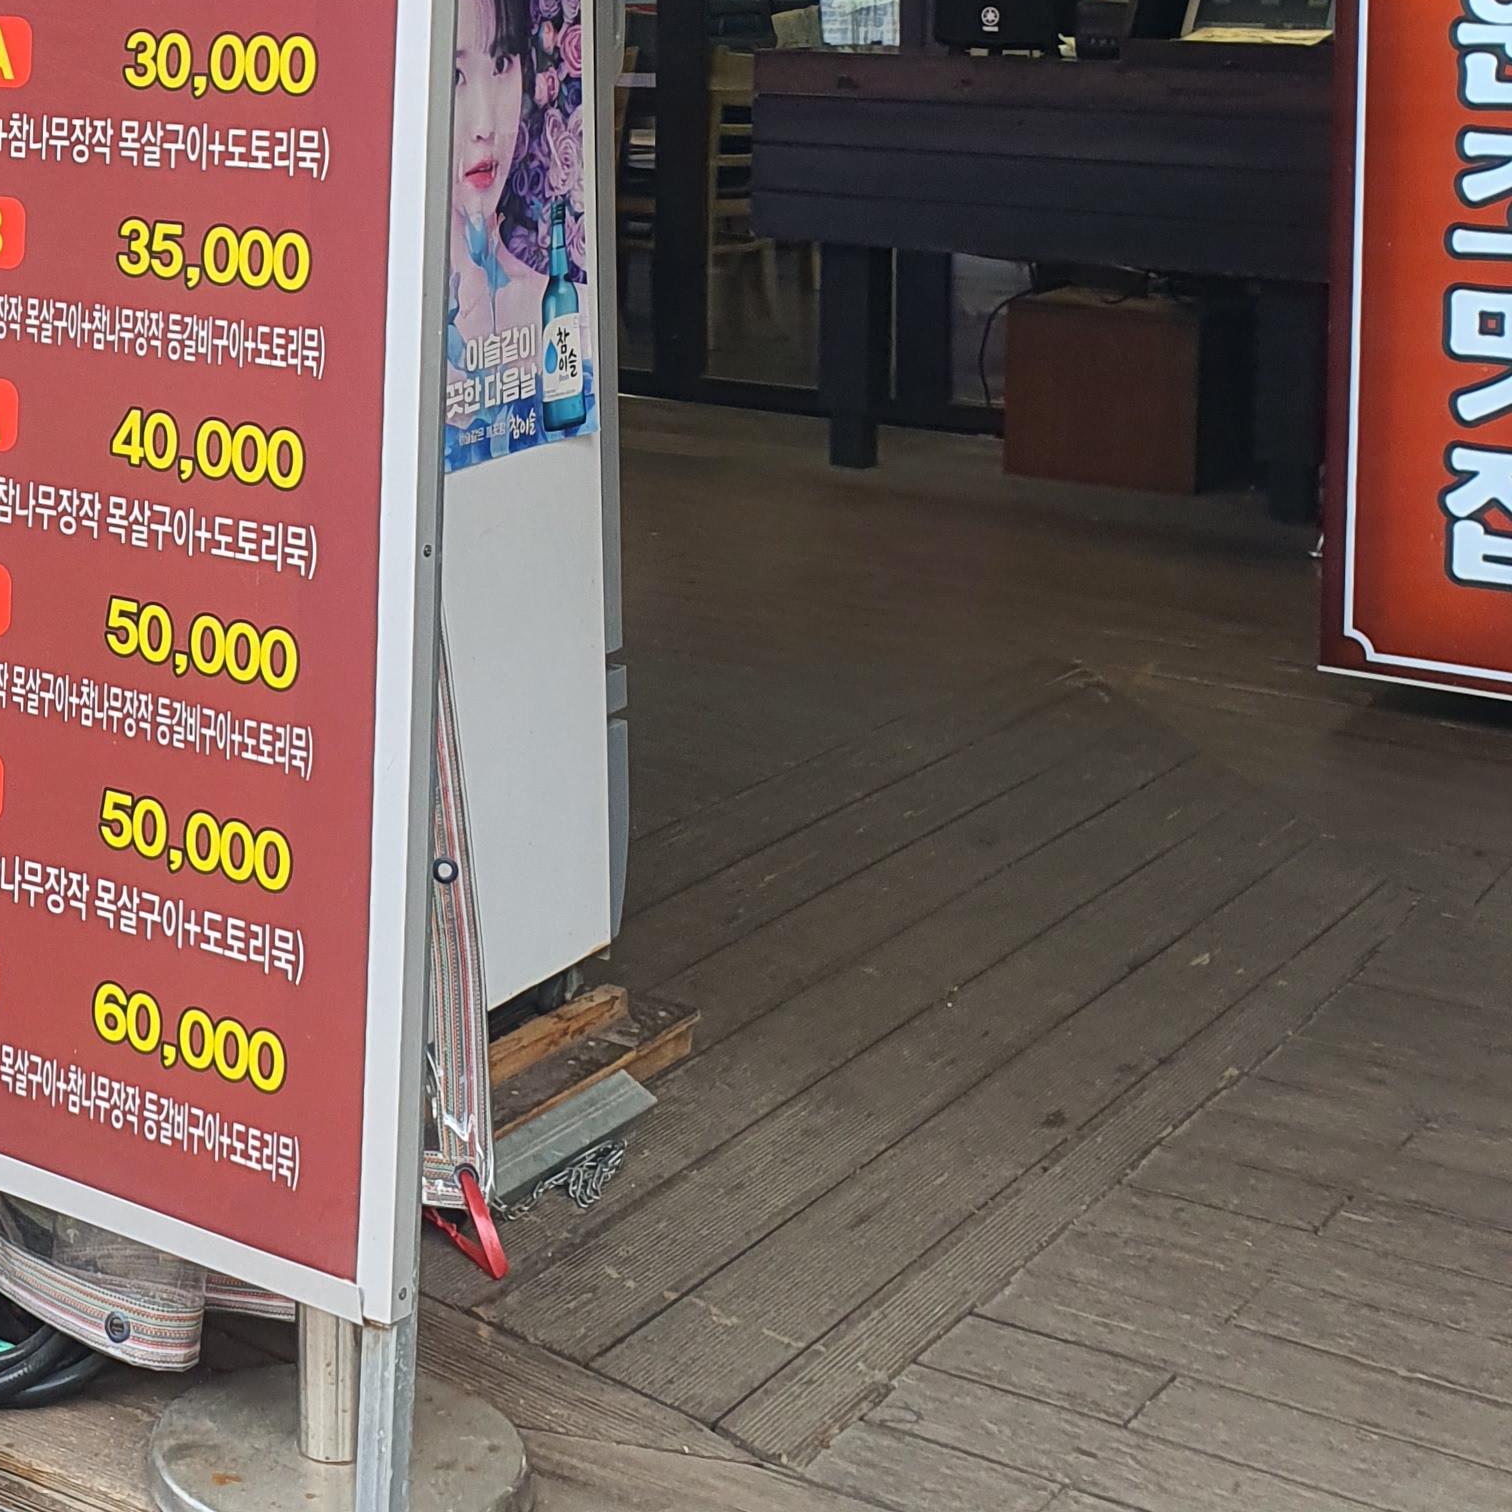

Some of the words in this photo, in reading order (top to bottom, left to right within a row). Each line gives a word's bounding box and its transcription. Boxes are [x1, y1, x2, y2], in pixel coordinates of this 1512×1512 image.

[123, 29, 318, 98] 30,000
[119, 119, 330, 180] 목살구이+도토리묵)
[117, 217, 311, 292] 35,000
[466, 324, 536, 372] 이슬같이
[485, 363, 537, 408] 다음날
[110, 408, 304, 490] 40,000
[106, 496, 317, 580] 목살구이+도토리묵)
[105, 595, 299, 692] 50,000
[99, 788, 292, 892] 50,000
[94, 879, 304, 985] 목살구이+도토리묵)
[93, 981, 286, 1092] 60,000
